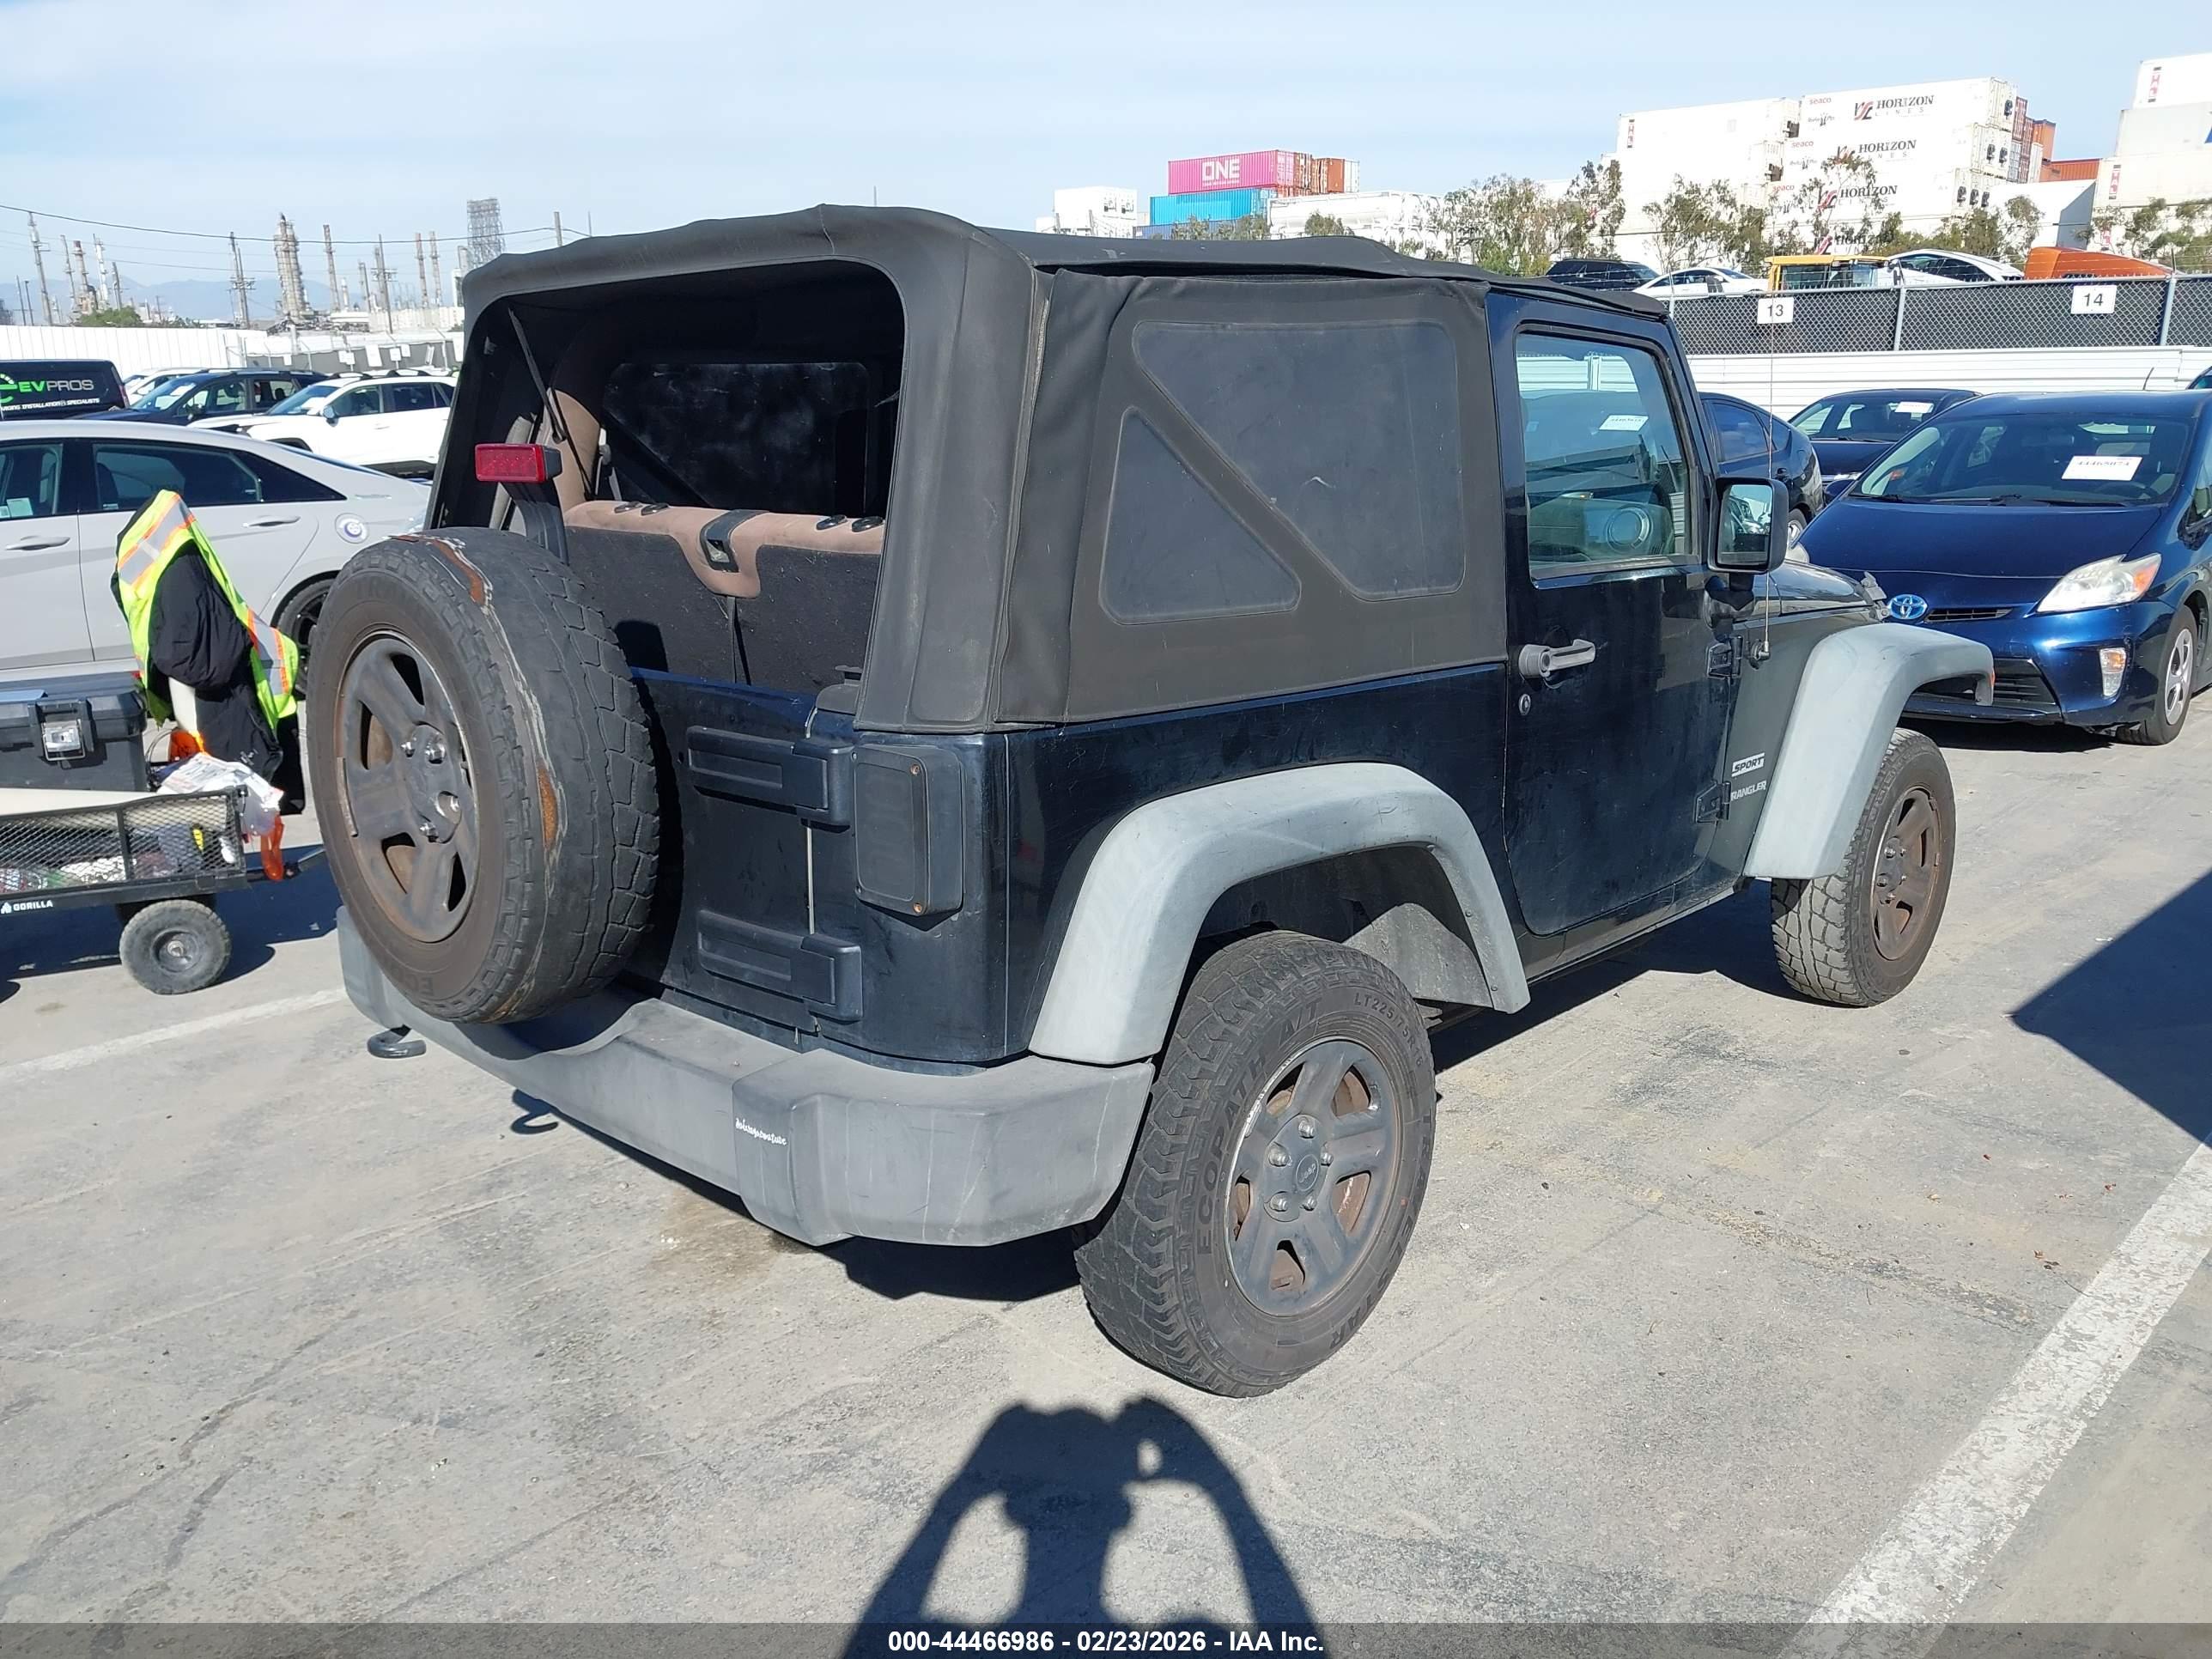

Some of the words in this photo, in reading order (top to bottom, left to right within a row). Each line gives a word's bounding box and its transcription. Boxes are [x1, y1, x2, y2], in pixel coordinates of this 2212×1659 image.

[1876, 94, 1934, 109] HORIZON
[1875, 107, 1924, 117] LINES
[1859, 140, 1917, 153] HORIZON
[1202, 159, 1240, 181] ONE
[1840, 185, 1897, 198] HORIZON
[2083, 293, 2103, 307] 14
[1767, 304, 1784, 317] 13
[21, 400, 60, 410] INSTALLATION
[1732, 756, 1765, 775] SPORT
[1730, 780, 1767, 801] RANGLER
[13, 900, 53, 911] GORILLA
[1298, 1163, 1316, 1183] Jeep
